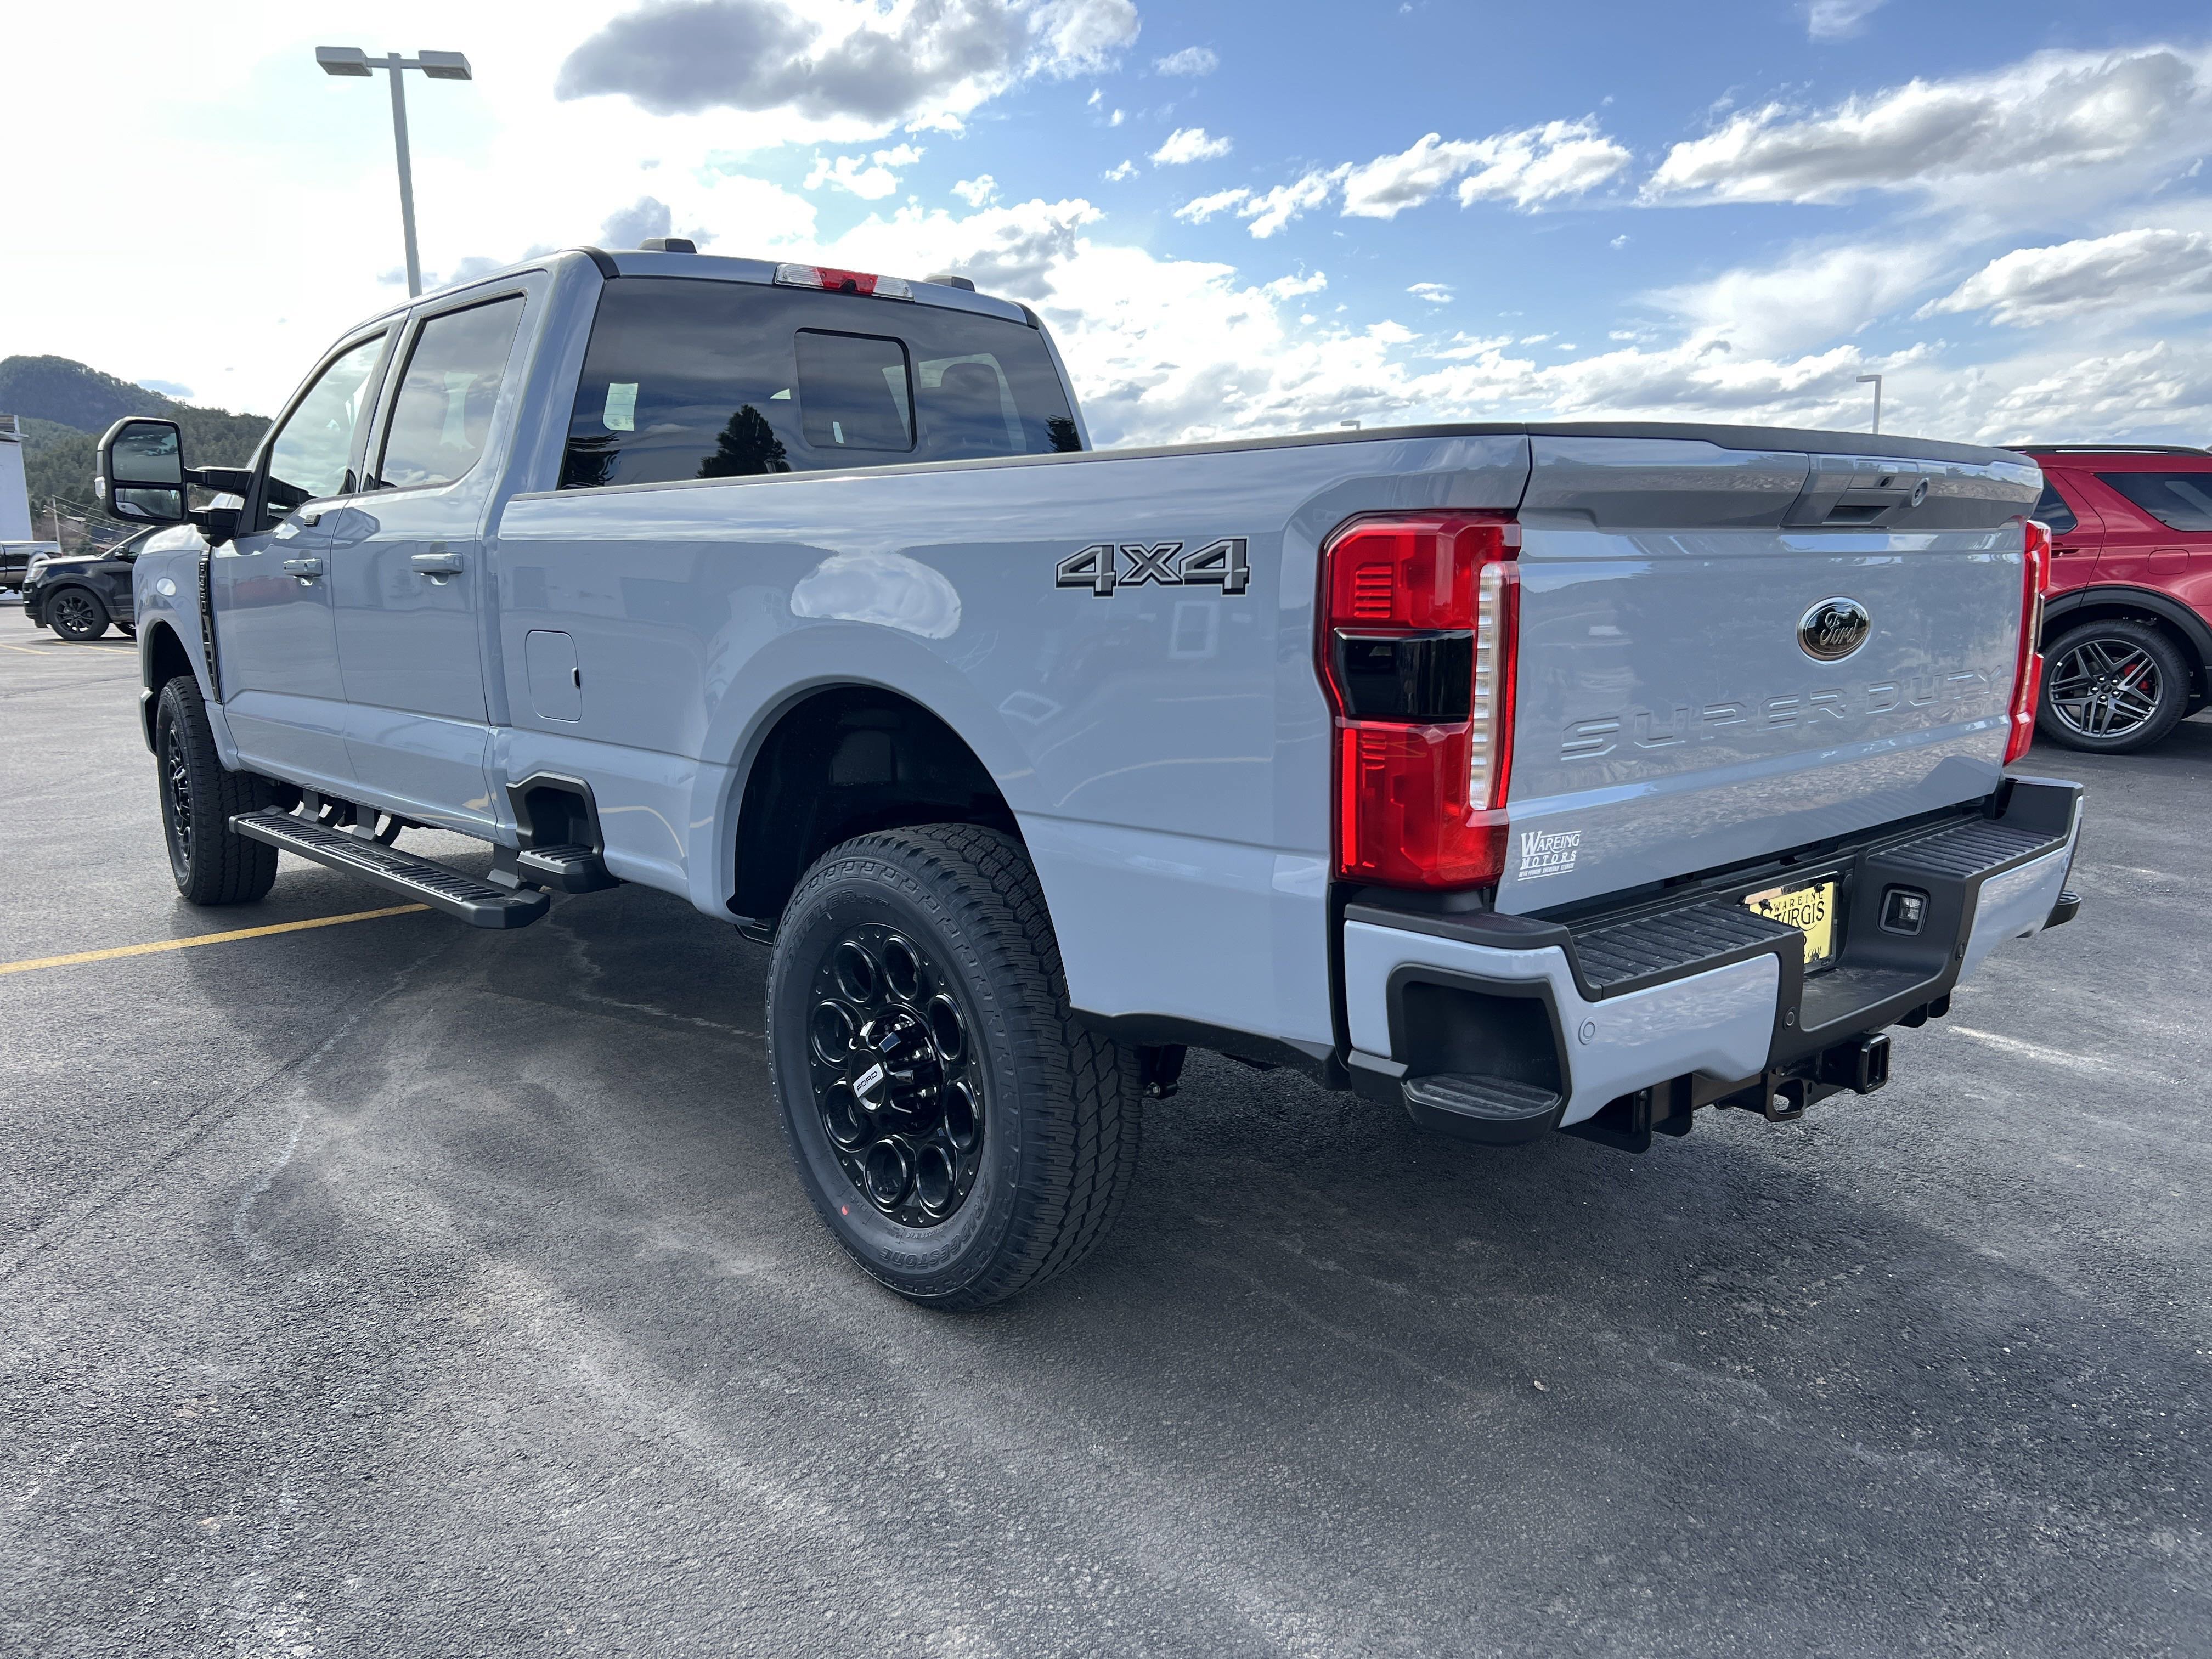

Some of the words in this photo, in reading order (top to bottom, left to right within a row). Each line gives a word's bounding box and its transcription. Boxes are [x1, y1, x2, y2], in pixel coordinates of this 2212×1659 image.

[1820, 611, 1859, 646] Ford
[1561, 689, 1848, 761] SUPER
[1866, 664, 2003, 714] DUTY
[1521, 831, 1581, 856] WAREING
[1520, 850, 1577, 870] MOTORS
[1774, 891, 1824, 912] WAREING
[857, 1071, 878, 1091] FORD
[879, 1172, 989, 1271] BRIDGESTONE
